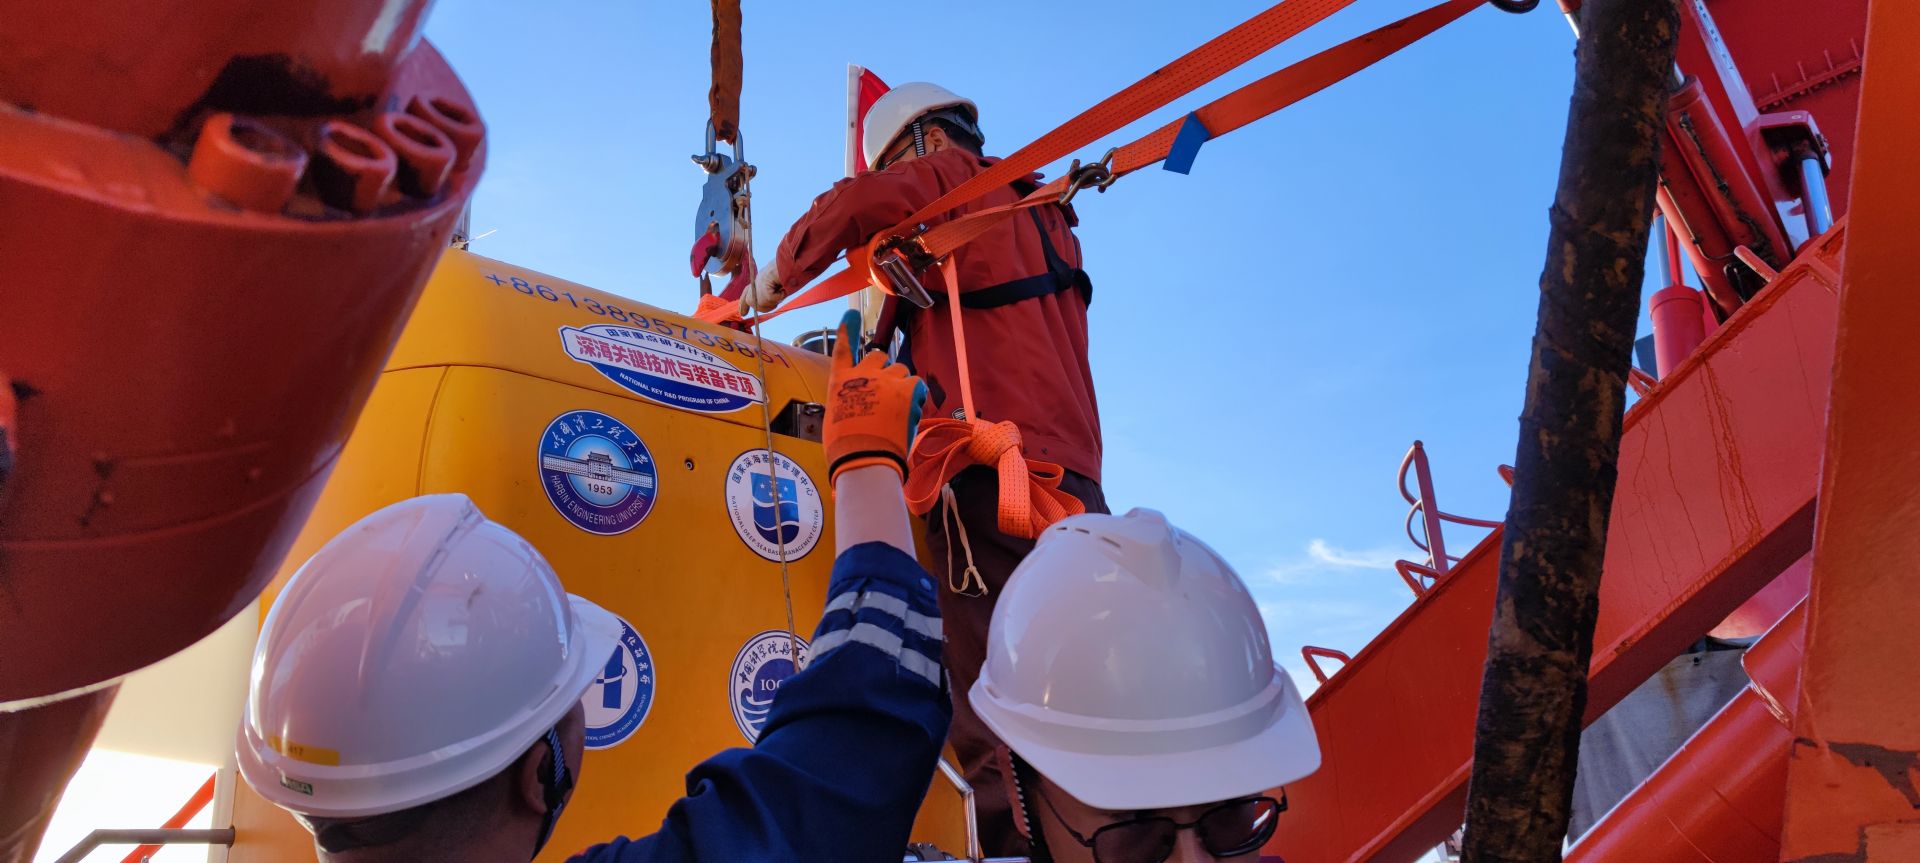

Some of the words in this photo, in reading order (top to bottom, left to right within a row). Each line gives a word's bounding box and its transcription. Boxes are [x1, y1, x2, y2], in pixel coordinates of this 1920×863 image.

[604, 328, 714, 360] 国家重点研发计划
[575, 334, 756, 396] 深海关键技术与装备专项
[619, 372, 650, 391] NATIONAL
[651, 386, 663, 396] KEY
[664, 391, 677, 400] R&D
[677, 394, 707, 404] PROGRAM
[713, 397, 731, 405] CHINA
[550, 474, 571, 504] HARBIN
[567, 500, 616, 525] ENGINEERING
[615, 489, 648, 524] UNIVERSITY
[587, 483, 613, 495] 1953
[731, 495, 745, 529] NATIONAL
